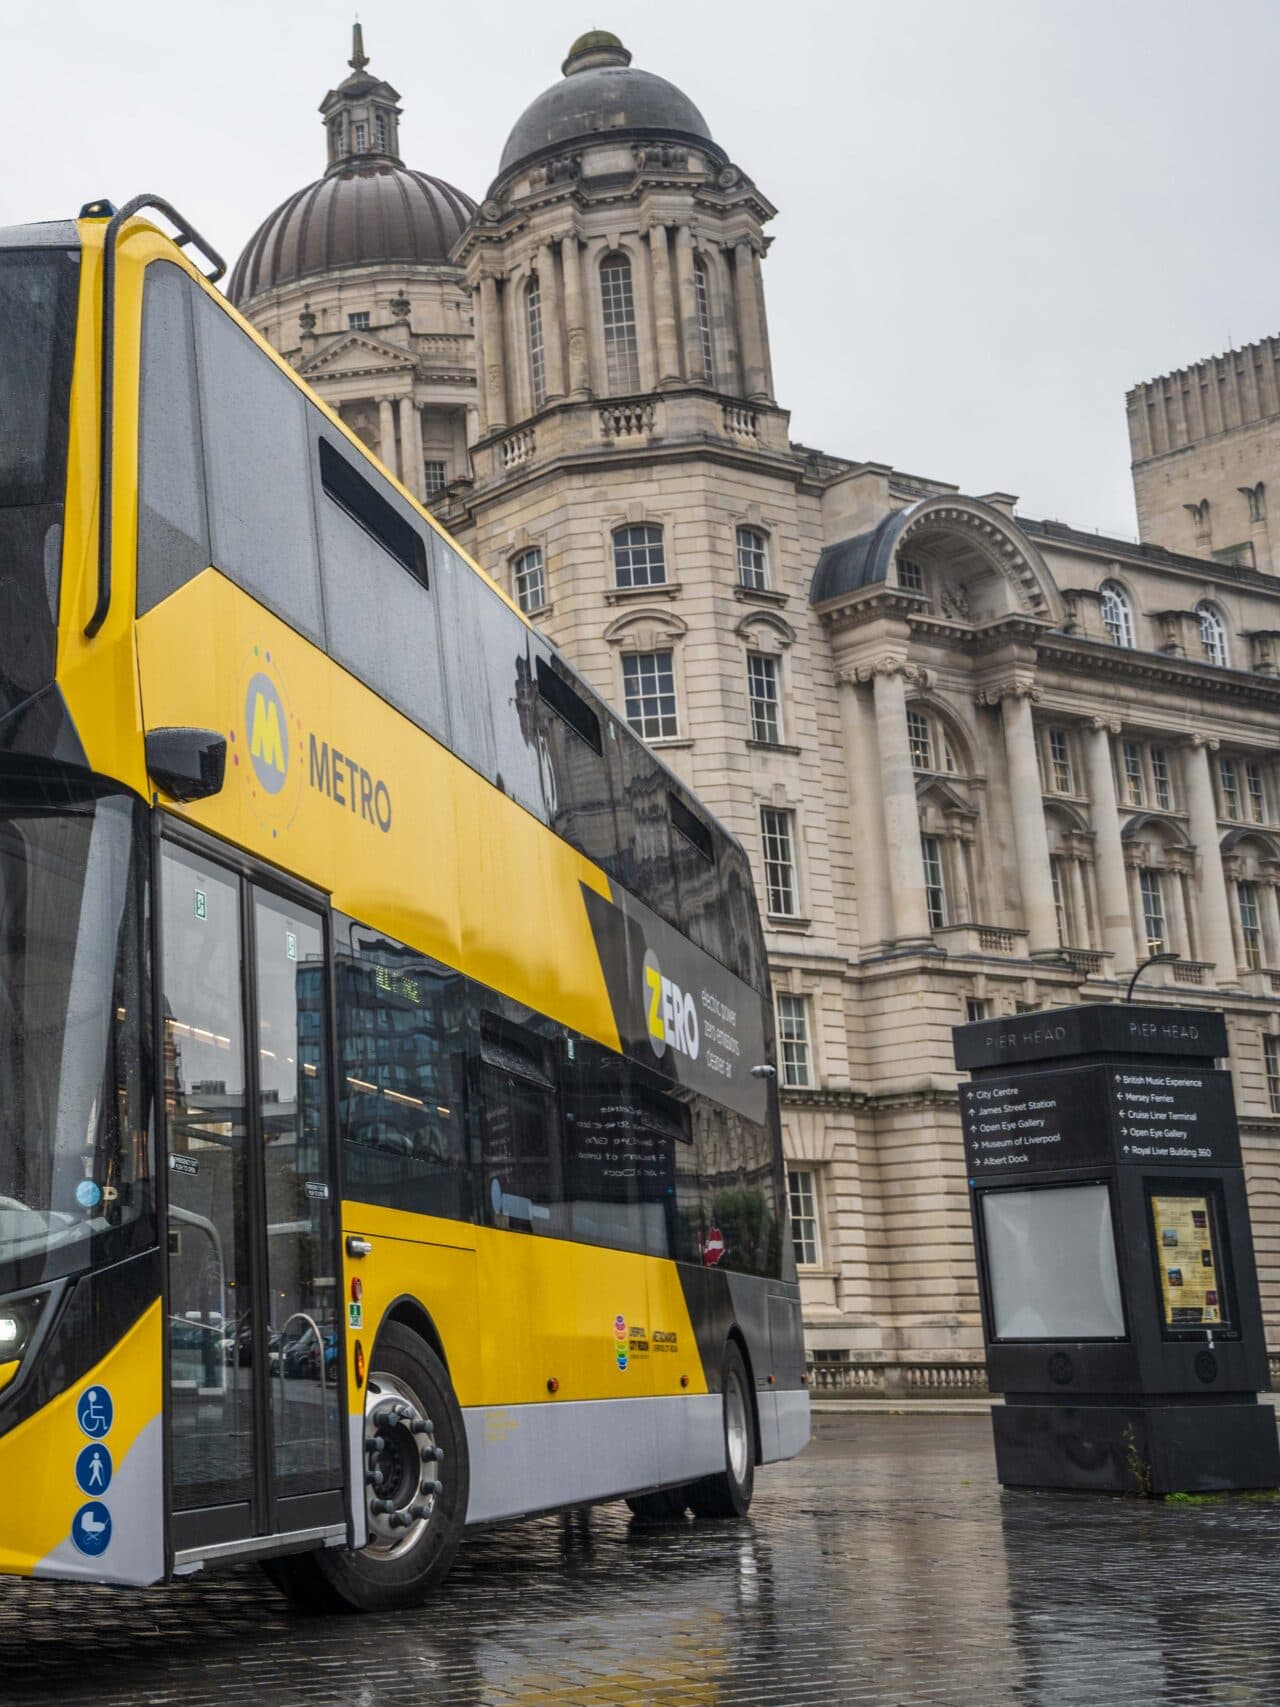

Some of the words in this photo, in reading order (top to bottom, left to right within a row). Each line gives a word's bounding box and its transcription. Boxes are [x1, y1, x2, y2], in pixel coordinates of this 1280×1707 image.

[251, 692, 285, 773] M
[309, 733, 392, 832] METRO
[645, 965, 700, 1061] ZERO
[985, 1032, 1017, 1048] PIER
[1022, 1026, 1066, 1046] HEAD
[1128, 1022, 1157, 1038] PIER
[1161, 1025, 1199, 1040] HEAD
[1123, 1075, 1145, 1085] British
[1145, 1076, 1165, 1086] Music
[1166, 1077, 1203, 1088] Experience
[976, 1091, 991, 1100] City
[993, 1088, 1019, 1098] Centre
[1125, 1093, 1150, 1104] Mersey
[1150, 1094, 1174, 1103] Ferries
[979, 1106, 1002, 1116] James
[1003, 1104, 1027, 1114] Street
[1028, 1100, 1057, 1110] Station
[1127, 1110, 1149, 1120] Cruise
[1150, 1111, 1167, 1120] Liner
[1168, 1111, 1197, 1121] Terminal
[980, 1124, 1000, 1133] Open
[1001, 1121, 1016, 1131] Eye
[1017, 1119, 1046, 1129] Gallery
[981, 1140, 1013, 1149] Museum
[1014, 1137, 1023, 1146] of
[1024, 1132, 1061, 1145] Liverpool
[1129, 1127, 1149, 1137] Open
[1150, 1128, 1163, 1139] Eye
[1164, 1129, 1187, 1140] Gallery
[1131, 1145, 1151, 1156] Royal
[1151, 1146, 1169, 1156] Liver
[1169, 1147, 1197, 1158] Building
[1197, 1148, 1212, 1158] 360
[983, 1156, 1007, 1166] Albert
[1008, 1154, 1029, 1164] Dock
